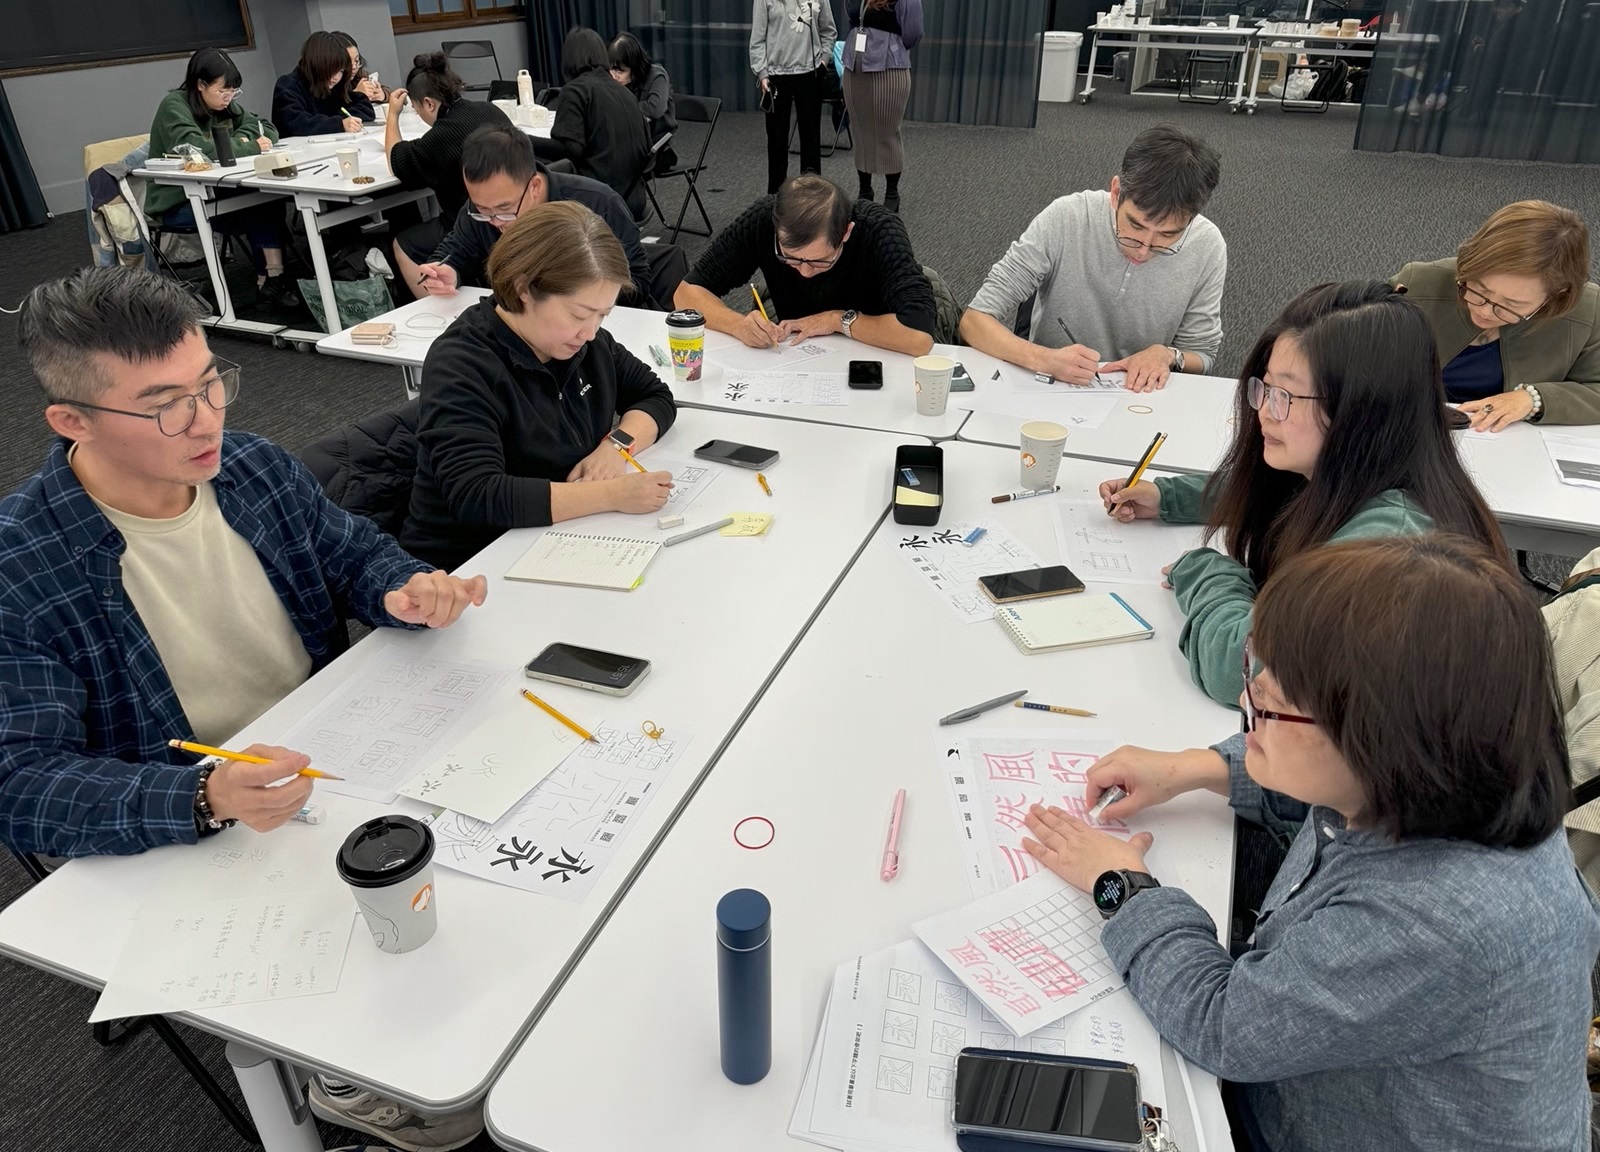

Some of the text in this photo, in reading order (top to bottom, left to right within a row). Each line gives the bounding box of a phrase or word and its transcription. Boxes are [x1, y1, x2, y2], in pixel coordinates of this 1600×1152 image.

[899, 535, 933, 552] 永
[931, 529, 964, 545] 永
[608, 663, 630, 681] 15:51
[490, 836, 544, 872] 永
[541, 846, 595, 883] 永
[945, 937, 1041, 1017] 自然風
